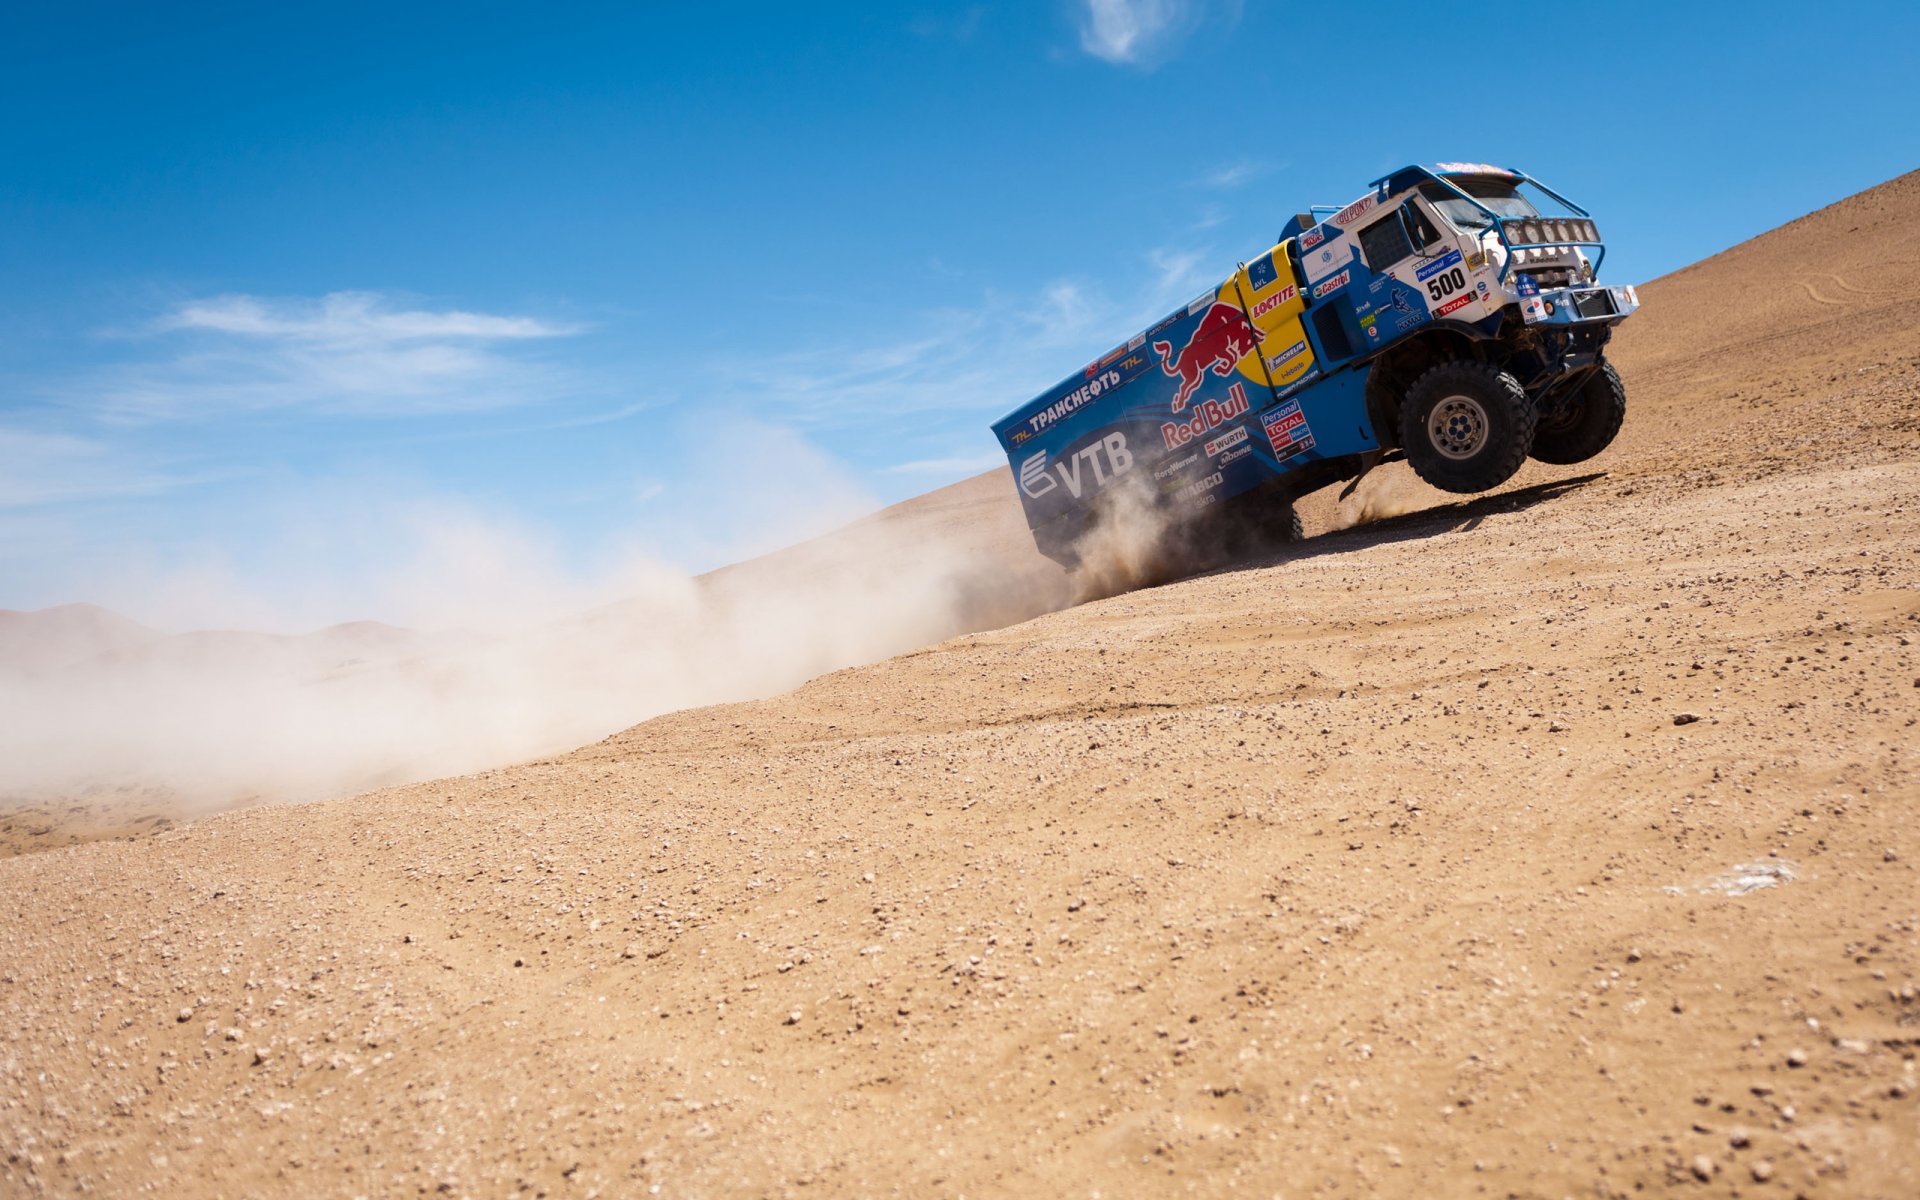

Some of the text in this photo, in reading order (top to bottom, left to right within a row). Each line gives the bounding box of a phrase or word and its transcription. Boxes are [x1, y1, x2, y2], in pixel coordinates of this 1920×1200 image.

[1418, 260, 1445, 277] Personal
[1254, 279, 1267, 291] AVL
[1322, 271, 1348, 294] Castrol
[1427, 267, 1466, 301] 500
[1252, 284, 1295, 319] LOCTITE
[1440, 298, 1469, 313] TOTAL
[1274, 341, 1305, 366] MICHELIN
[1029, 370, 1120, 432] ТРАНСНЕФТЬ
[1160, 381, 1250, 452] Red Bull
[1264, 402, 1297, 426] Personal
[1268, 415, 1304, 436] TOTAL
[1055, 431, 1133, 499] VTB
[1154, 453, 1198, 481] BorgWarner
